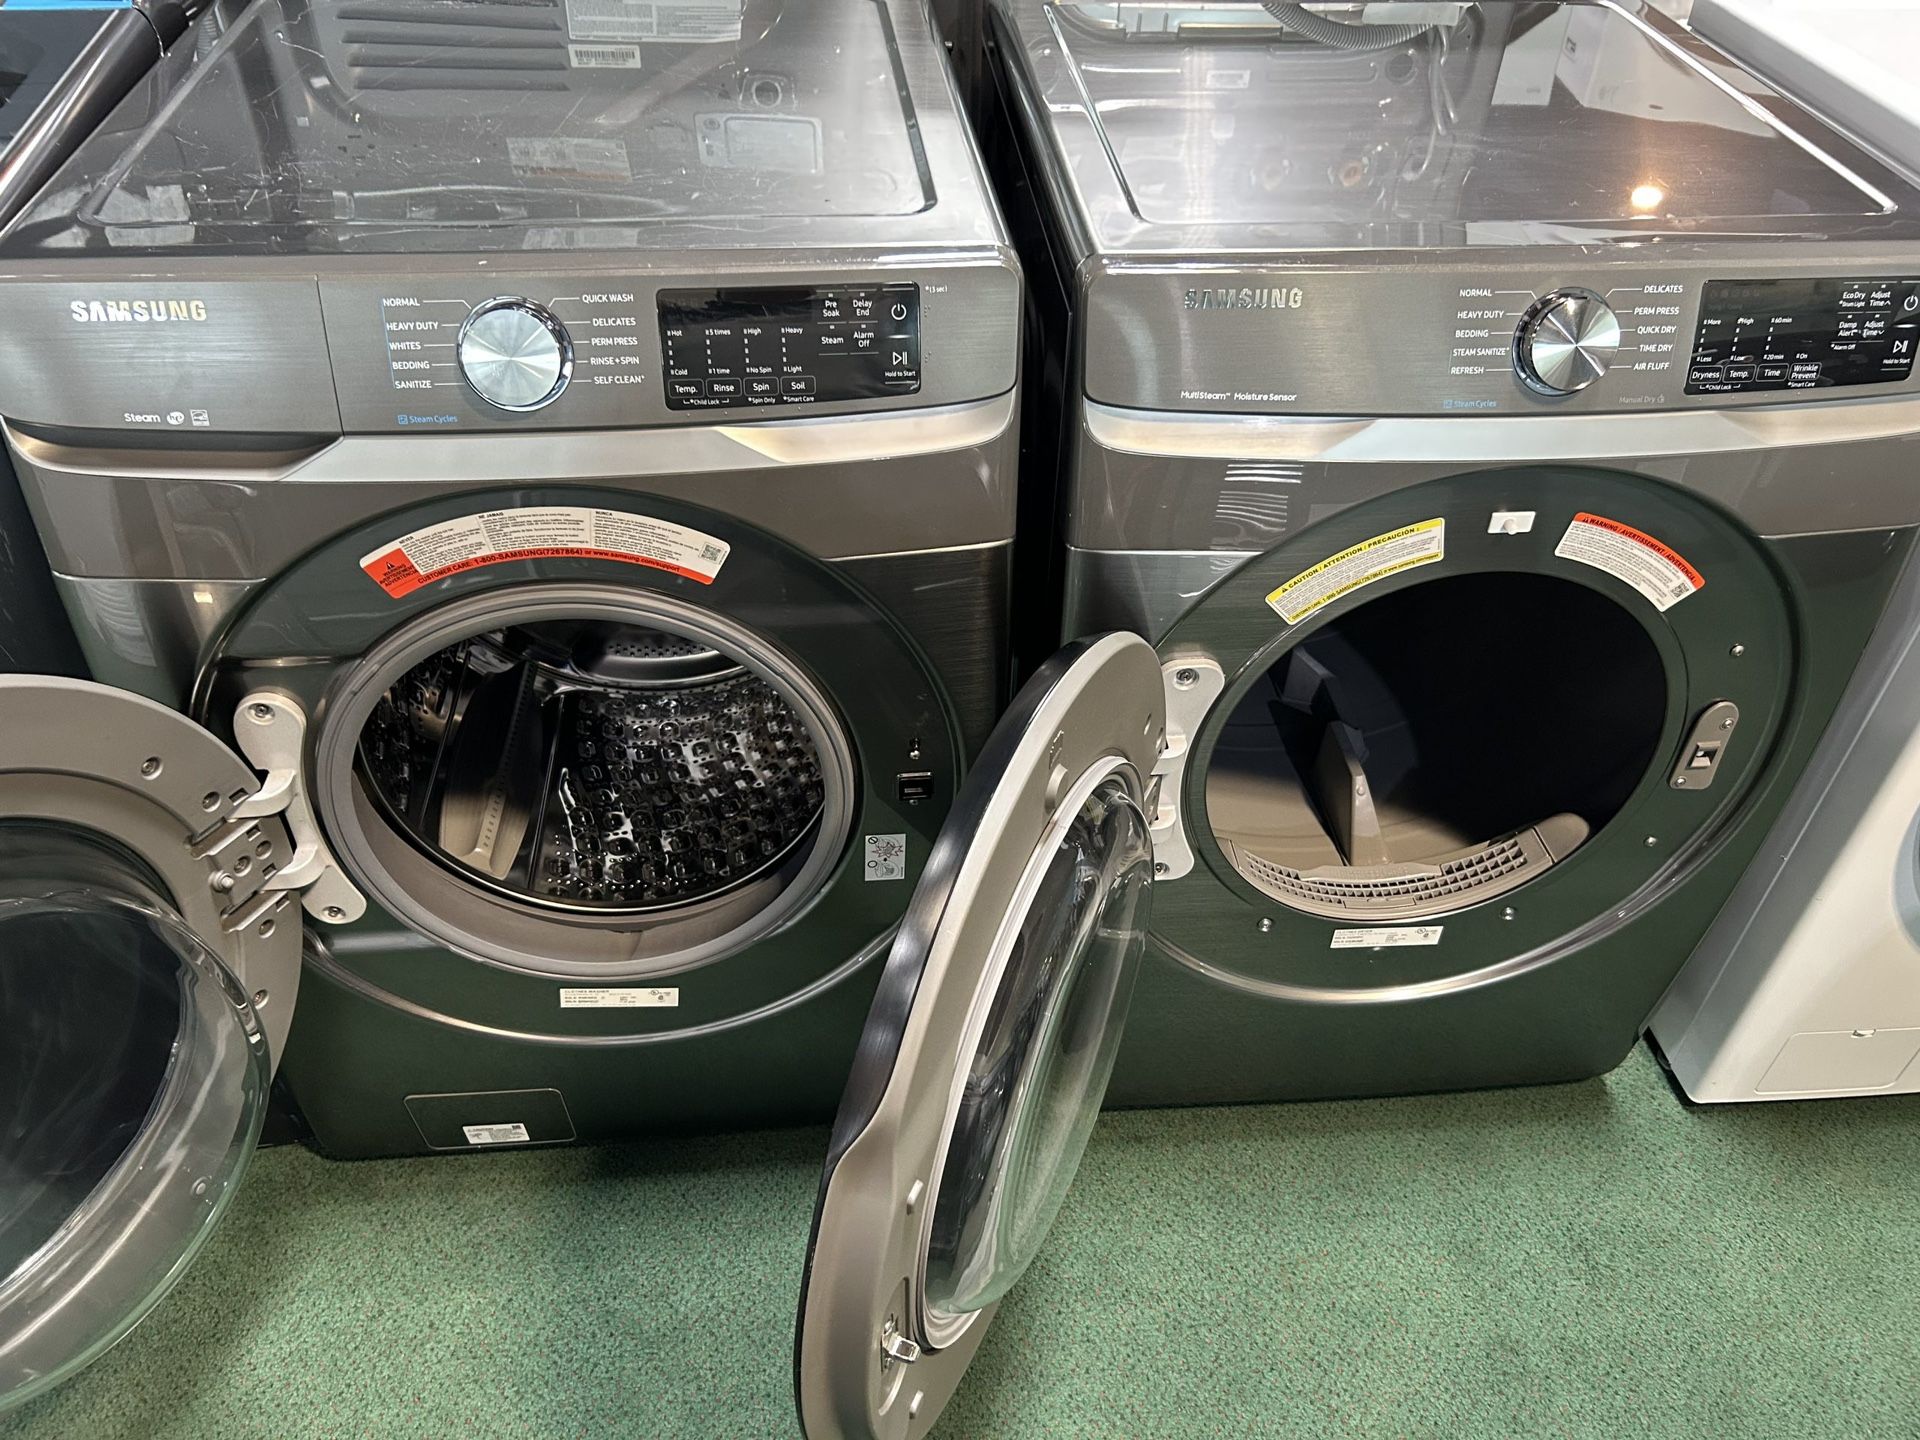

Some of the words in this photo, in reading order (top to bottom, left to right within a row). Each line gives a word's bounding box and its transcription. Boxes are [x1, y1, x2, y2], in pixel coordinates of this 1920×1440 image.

[1460, 288, 1492, 297] NORMAL
[1644, 285, 1683, 294] DELICATES
[582, 294, 609, 303] QUICK
[610, 294, 634, 302] WASH
[1184, 288, 1303, 309] SAMSUNG
[1854, 292, 1866, 300] Dry
[1871, 291, 1891, 300] Adjust
[383, 299, 420, 307] NORMAL
[825, 300, 838, 308] Pre
[852, 300, 872, 308] Delay
[71, 300, 207, 322] SAMSUNG
[1458, 310, 1482, 319] HEAVY
[1484, 310, 1504, 318] DUTY
[1634, 307, 1656, 315] PERM
[1657, 306, 1680, 315] PRESS
[386, 322, 414, 330] HEAVY
[416, 321, 438, 330] DUTY
[592, 317, 636, 326] DELICATES
[1864, 321, 1884, 329] Adjust
[785, 326, 804, 334] Heavy
[1456, 330, 1488, 338] BEDDING
[1637, 326, 1660, 334] QUICK
[1661, 326, 1677, 334] DRY
[591, 337, 615, 346] PERM
[616, 336, 638, 346] PRESS
[821, 337, 844, 345] Steam
[390, 342, 422, 350] WHITES
[1639, 344, 1656, 352] TIME
[1656, 344, 1673, 352] DRY
[1452, 348, 1476, 356] STEAM
[392, 361, 430, 370] BEDDING
[590, 357, 614, 366] RINSE
[620, 356, 640, 365] SPIN
[1450, 366, 1484, 374] REFRESH
[1634, 363, 1646, 371] AIR
[1648, 362, 1670, 370] FLUFF
[1793, 364, 1818, 372] Wrinkle
[1692, 371, 1720, 380] Dryness
[1730, 370, 1750, 378] Temp.
[395, 380, 432, 389] SANITIZE
[594, 376, 614, 384] SELF
[675, 384, 698, 394] Temp.
[714, 384, 734, 392] Rinse
[753, 382, 770, 392] Spin
[791, 382, 806, 390] Soil
[1234, 392, 1268, 401] Moisture
[1269, 393, 1298, 402] Sensor
[124, 412, 161, 423] Steam
[409, 415, 434, 424] Steam
[434, 414, 458, 424] Cycles
[1588, 518, 1618, 532] WARNING
[1288, 568, 1319, 589] CAUTION
[1323, 547, 1363, 569] ATTENTION
[418, 567, 452, 584] CUSTOMER
